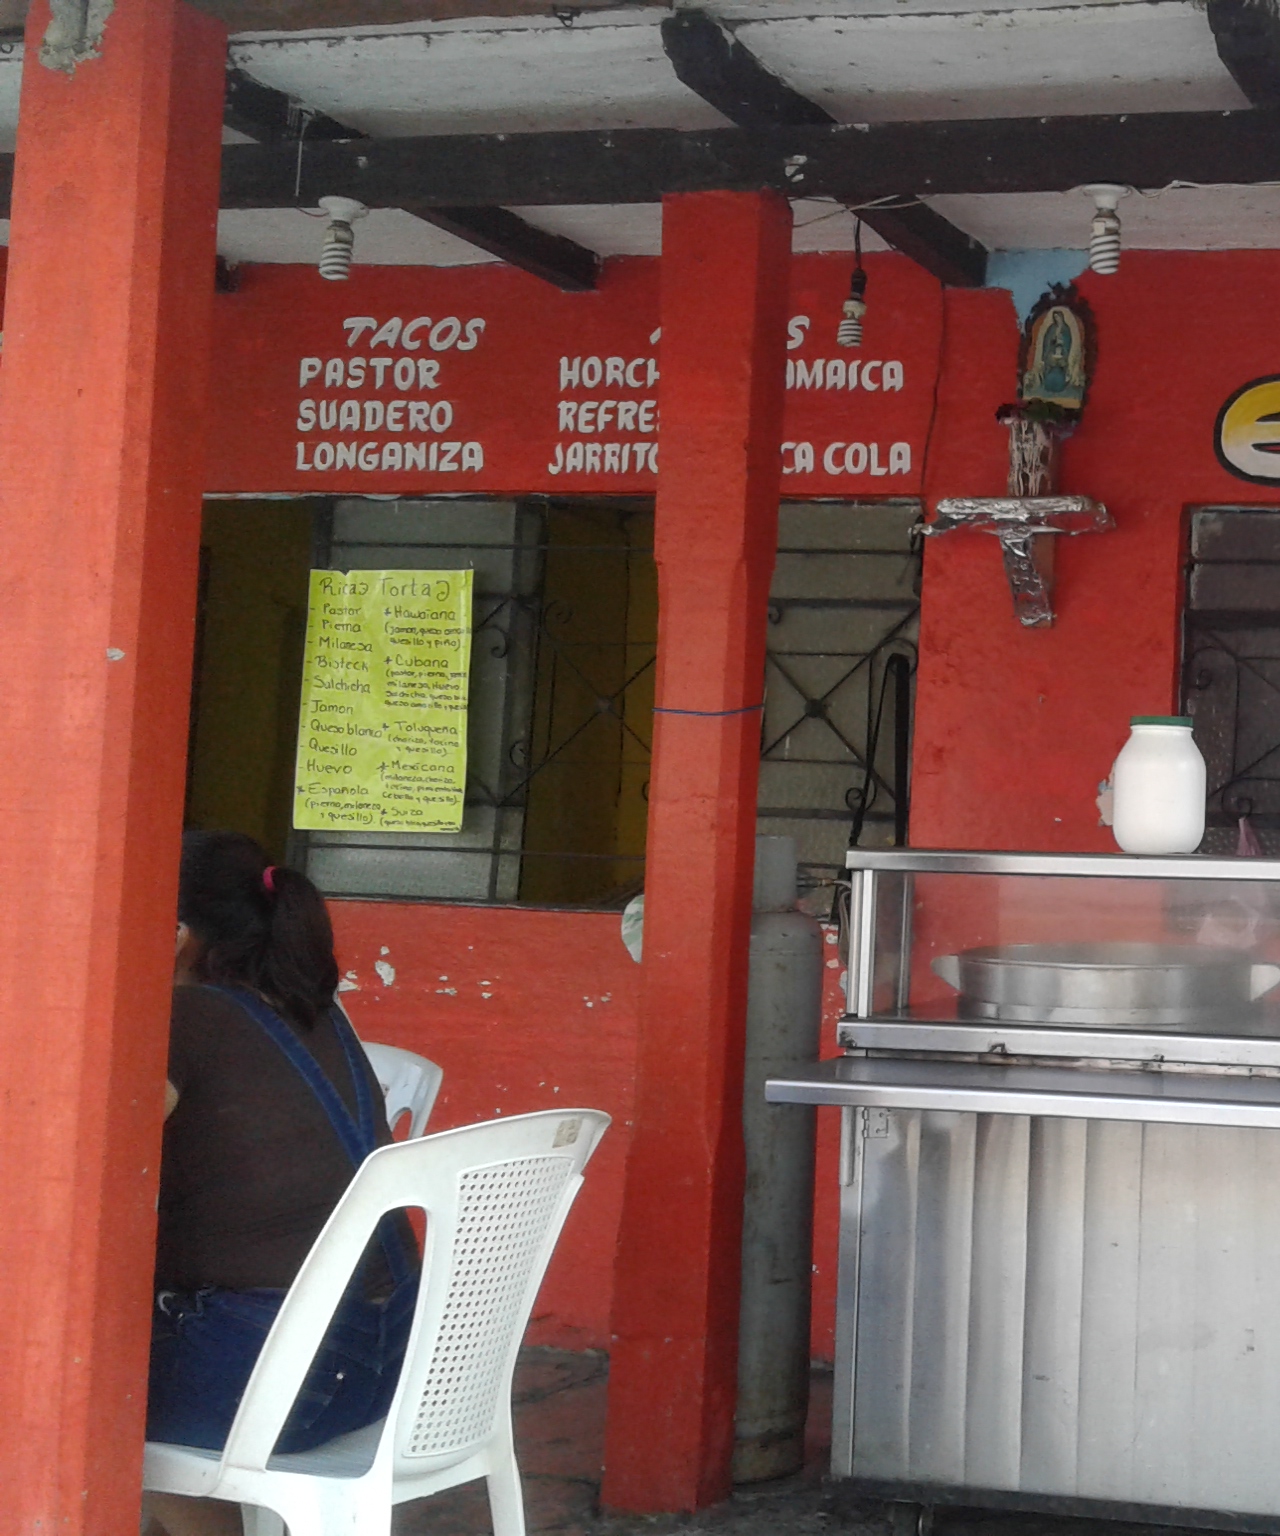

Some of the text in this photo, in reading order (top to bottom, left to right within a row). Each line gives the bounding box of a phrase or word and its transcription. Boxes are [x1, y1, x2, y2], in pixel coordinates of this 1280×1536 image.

[343, 316, 486, 351] TACOS
[299, 356, 441, 391] PASTOR
[559, 355, 905, 393] HORCH MAICA
[297, 398, 453, 433] SUADERO
[557, 399, 660, 433] REFRE
[295, 440, 485, 473] LONGANIZA
[823, 441, 912, 476] COLA
[379, 577, 450, 601] Tortas
[323, 603, 361, 616] Pastor
[322, 619, 362, 633] Pierna
[396, 653, 449, 668] Cubana
[313, 674, 371, 694] Salchicha
[310, 699, 354, 715] Jamon
[308, 737, 358, 756] Quesillo
[307, 758, 353, 775] Huevo
